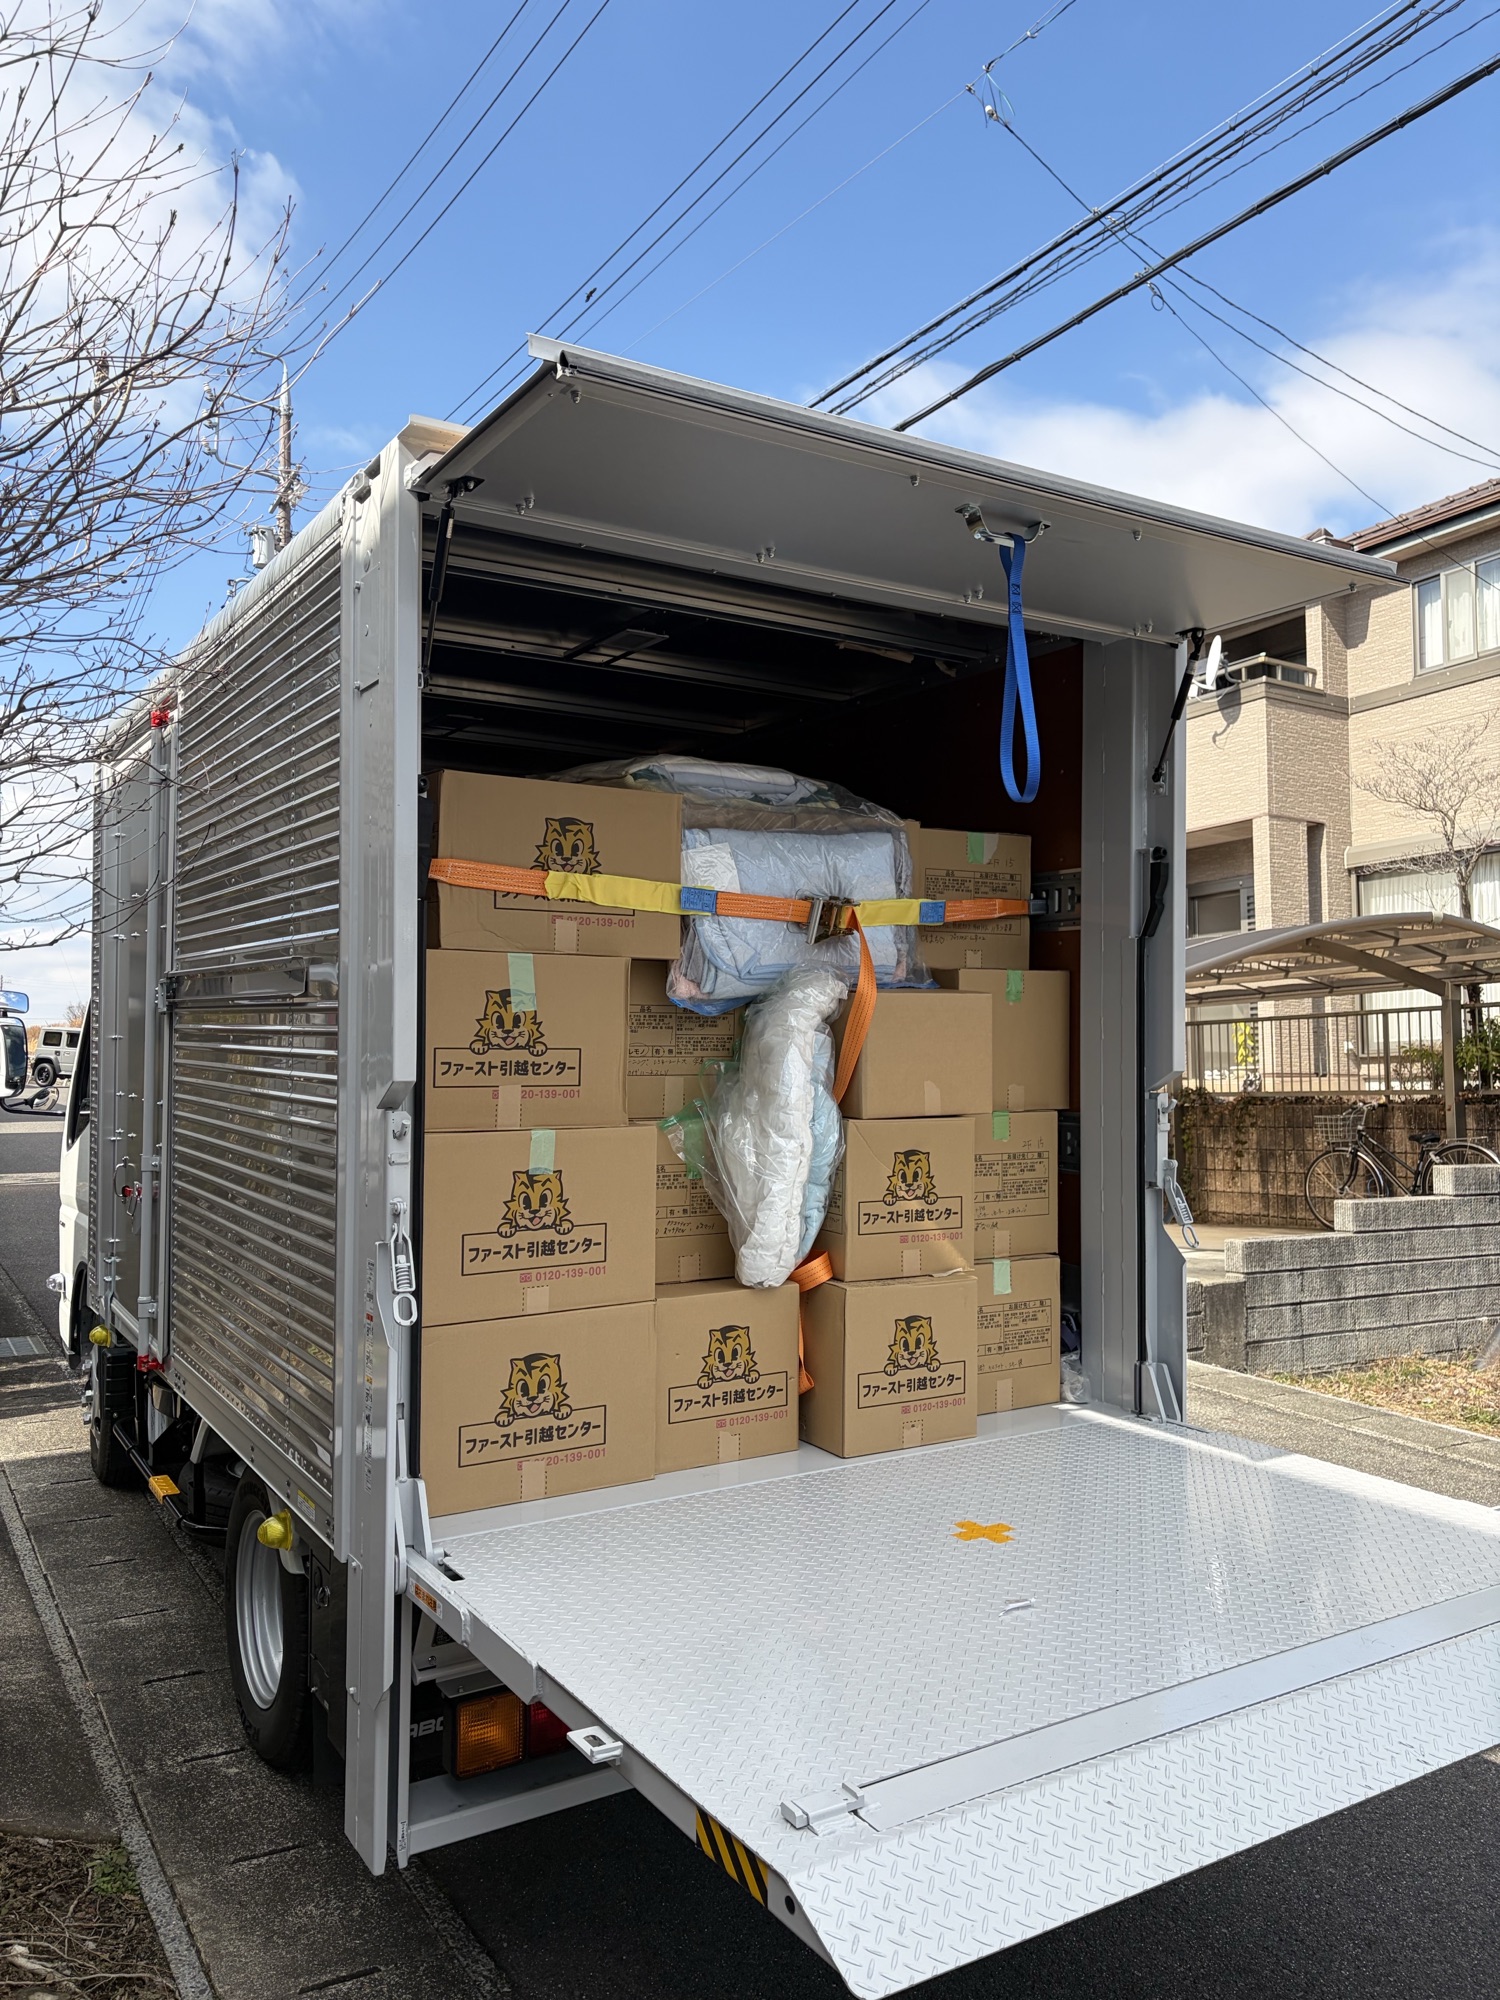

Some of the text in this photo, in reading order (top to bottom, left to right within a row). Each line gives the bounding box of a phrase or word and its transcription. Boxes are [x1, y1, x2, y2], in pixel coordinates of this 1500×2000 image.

[440, 1060, 576, 1076] ファースト引越センター
[863, 1207, 959, 1225] ファースト引越センター
[911, 1231, 963, 1243] 0120-139-001
[468, 1237, 602, 1263] ファースト引越センター
[535, 1265, 606, 1282] 0120-139-001
[863, 1373, 962, 1398] ファースト引越センター
[674, 1385, 783, 1412] ファースト引越センター
[913, 1397, 966, 1412] 0120-139-001
[729, 1410, 789, 1427] 0120-139-001
[465, 1421, 601, 1454] ファースト引越センター
